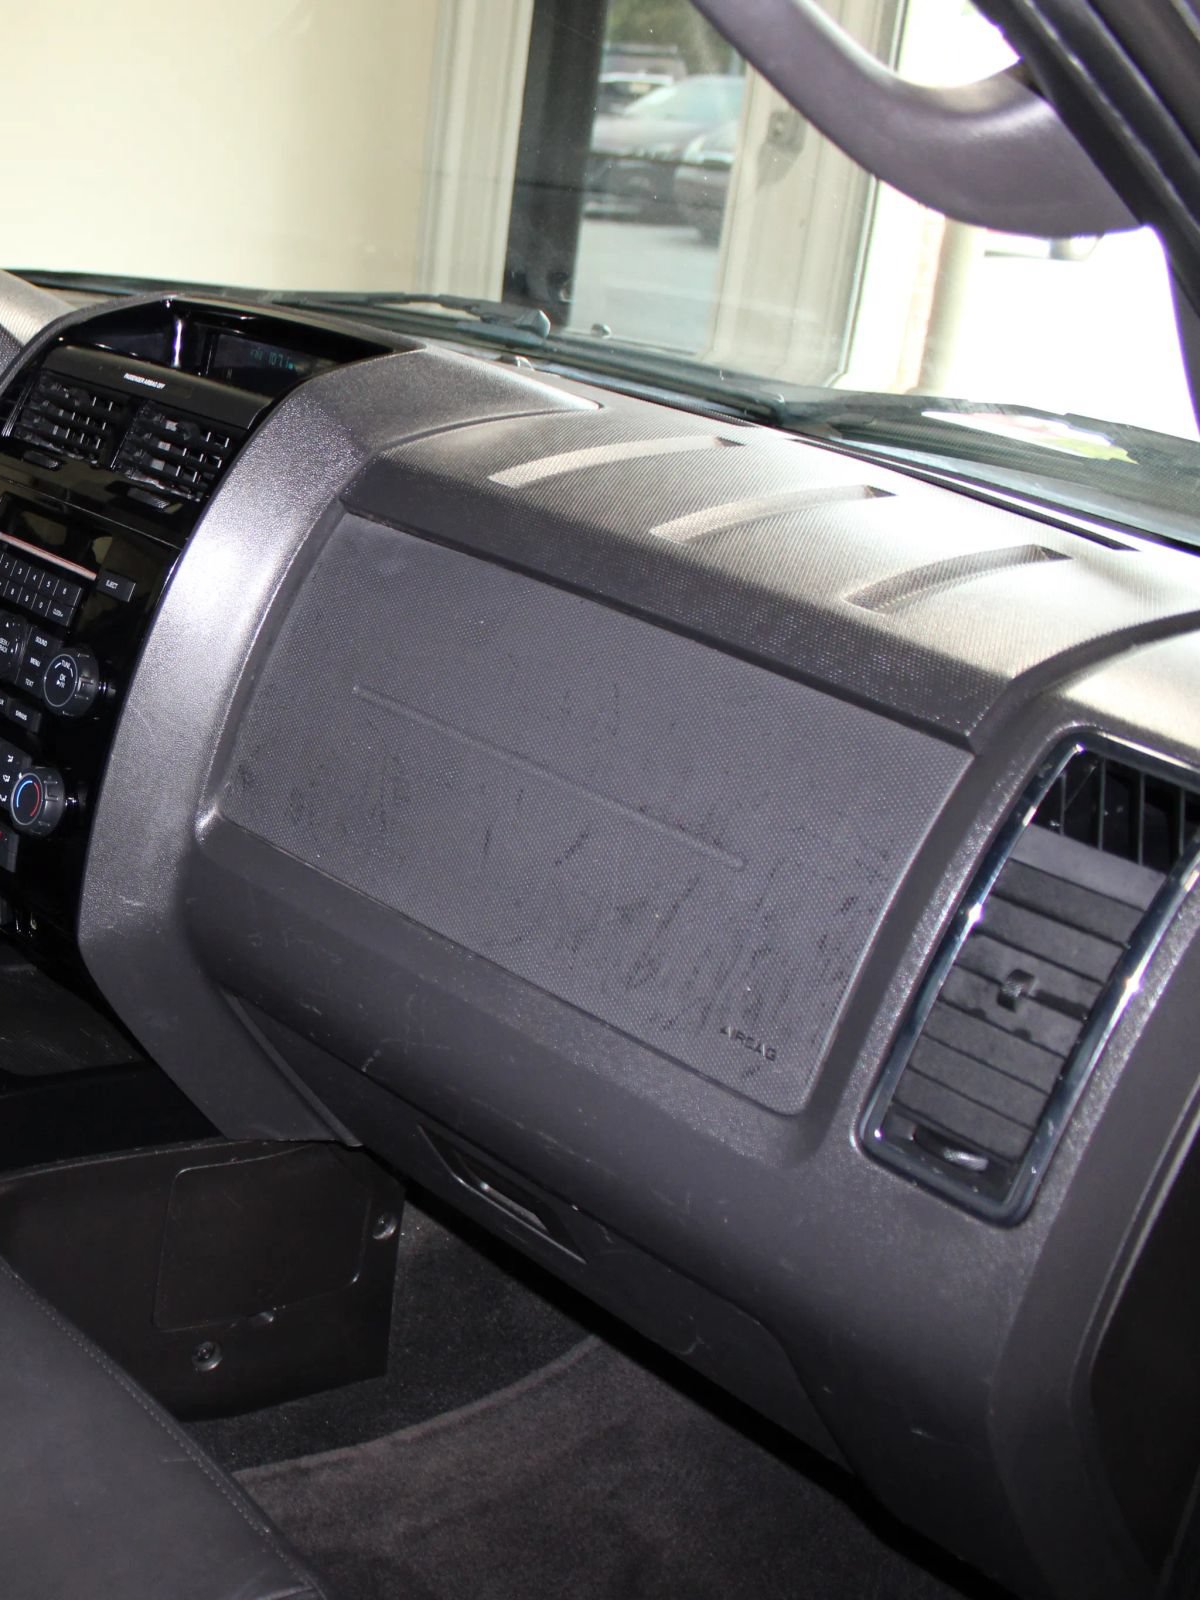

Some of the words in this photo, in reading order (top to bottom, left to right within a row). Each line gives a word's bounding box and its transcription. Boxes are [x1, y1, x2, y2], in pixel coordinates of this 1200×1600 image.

[35, 636, 48, 647] SOUND
[30, 657, 41, 667] MENU
[25, 678, 34, 687] TEXT
